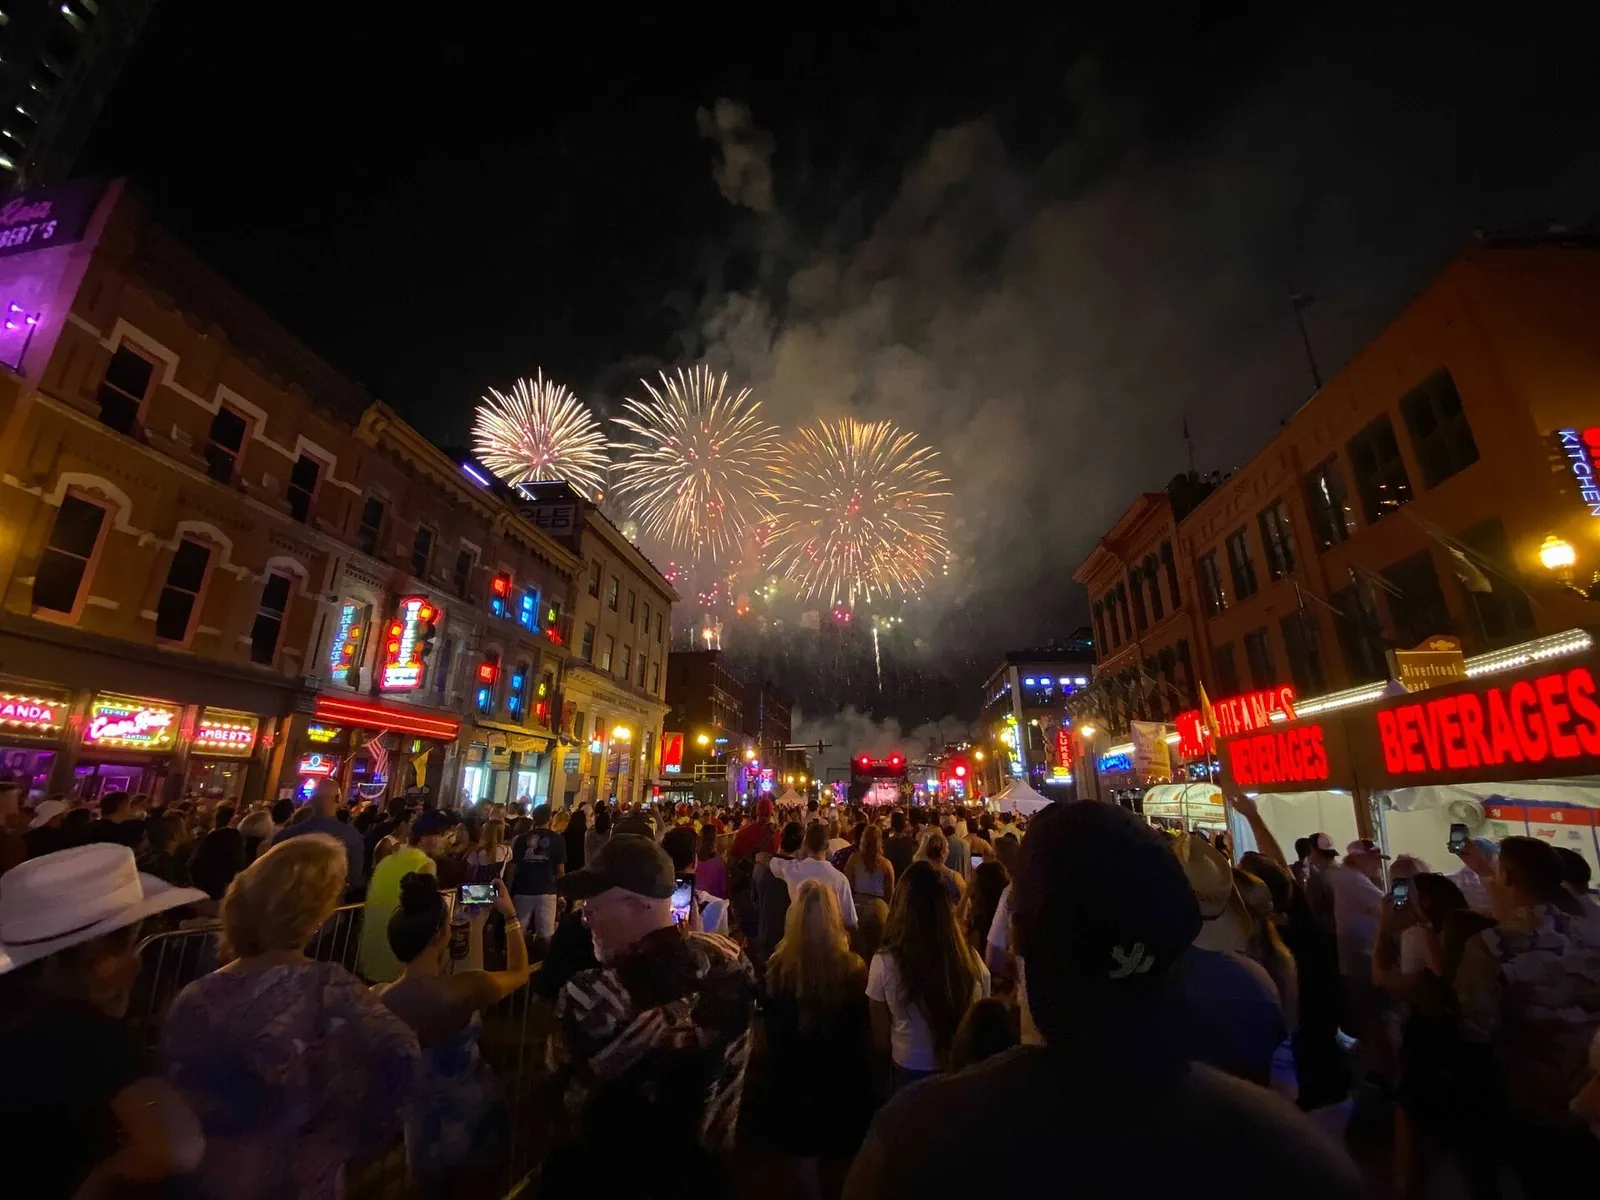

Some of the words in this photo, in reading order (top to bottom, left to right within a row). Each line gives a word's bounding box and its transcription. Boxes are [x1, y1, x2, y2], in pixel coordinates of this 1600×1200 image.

[1558, 430, 1600, 516] KITCHEN
[1401, 663, 1458, 677] Riverfront
[0, 704, 51, 720] ANDA
[1377, 667, 1600, 775] BEVERAGES
[1059, 731, 1072, 767] LUKE'S
[1230, 725, 1328, 784] BEVERAGES
